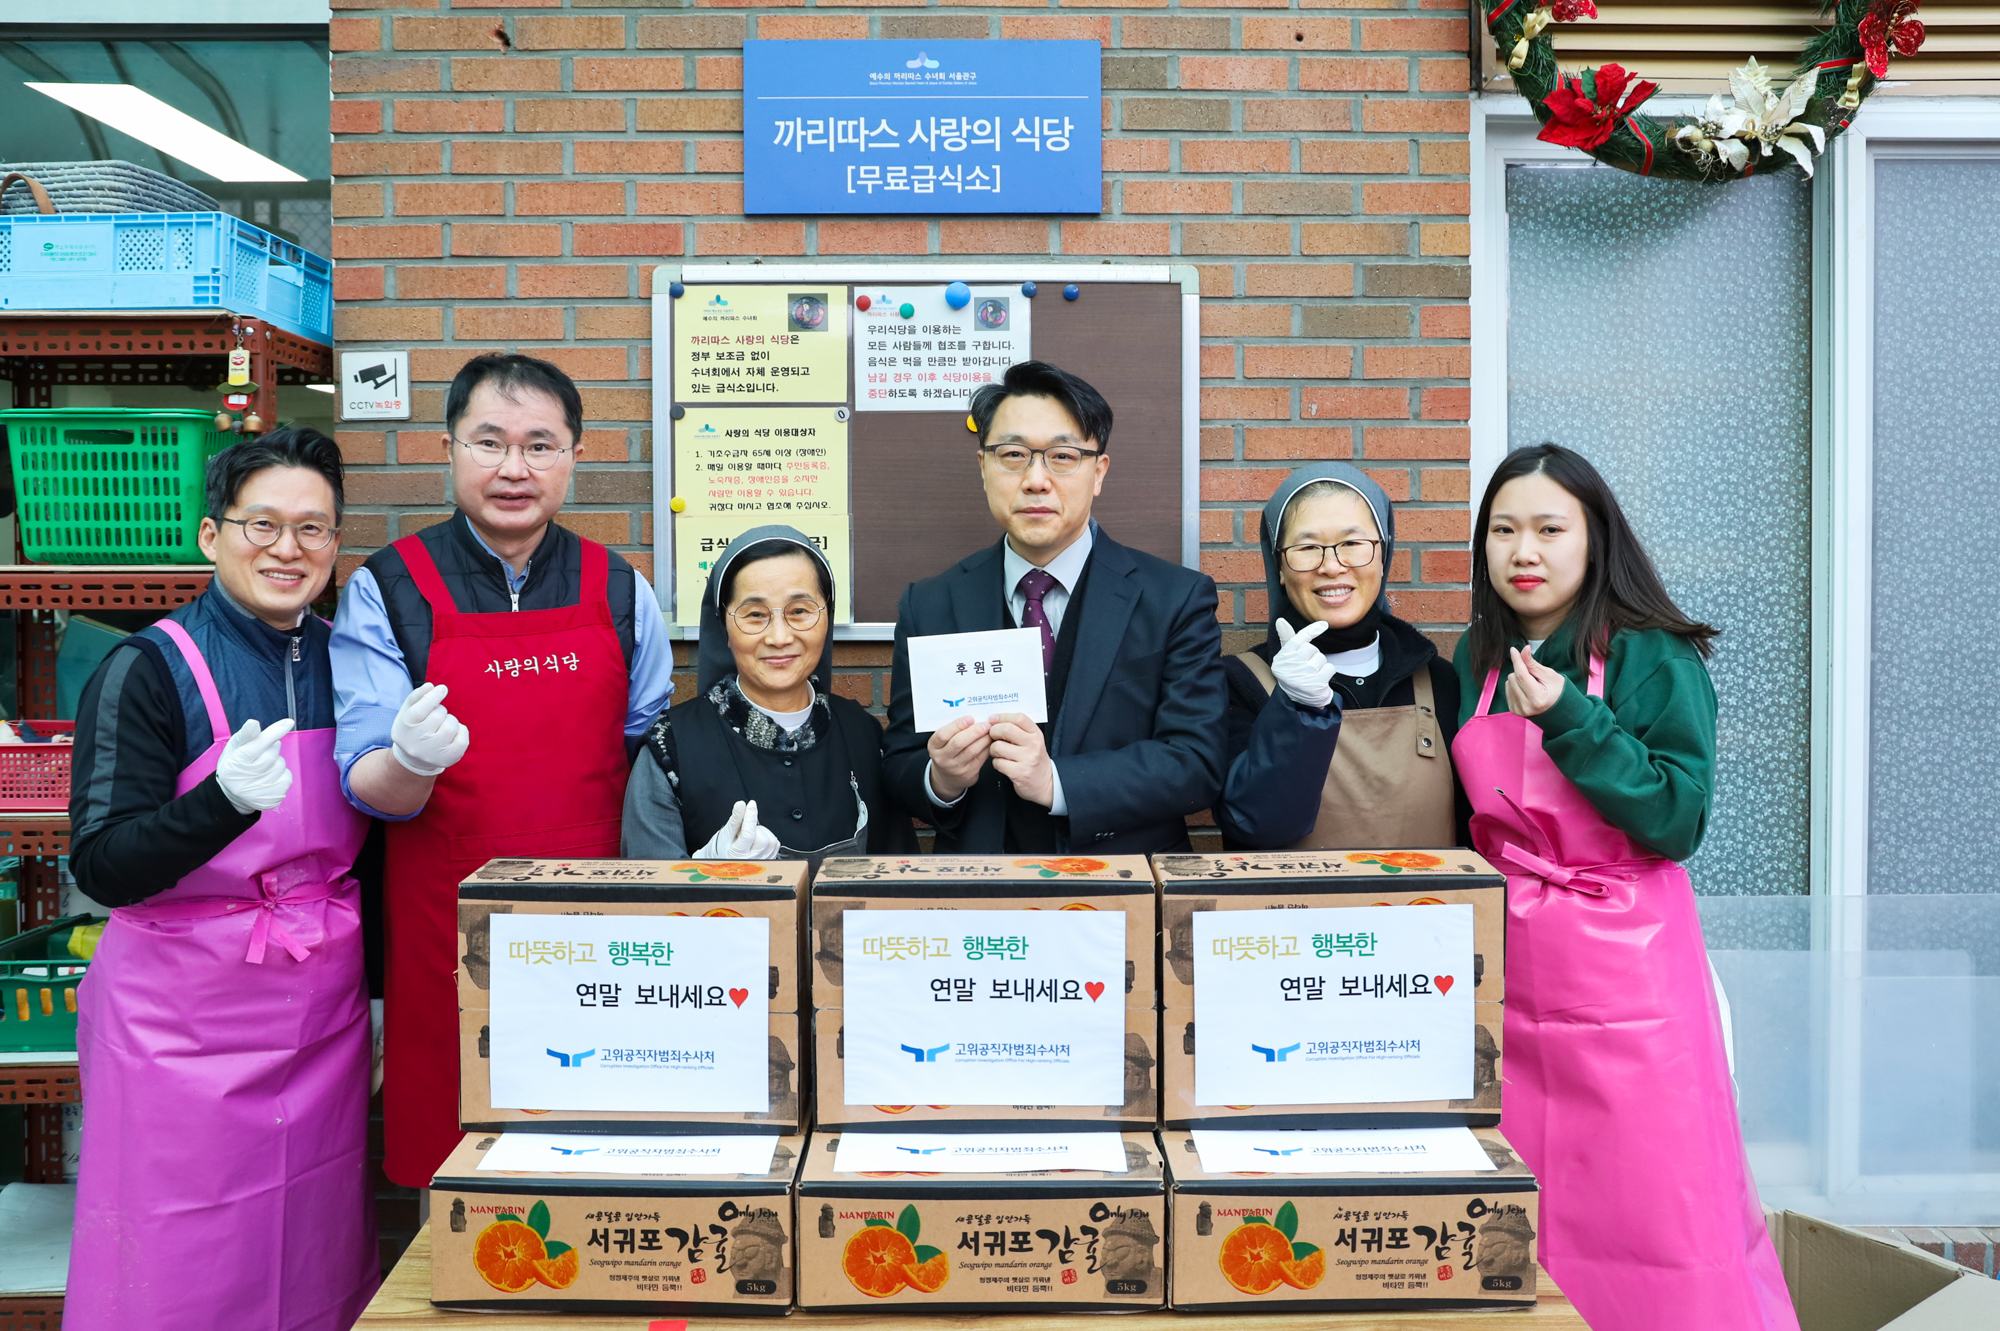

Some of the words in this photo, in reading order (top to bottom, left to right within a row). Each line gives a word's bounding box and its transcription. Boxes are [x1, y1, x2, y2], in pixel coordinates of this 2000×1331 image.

[869, 72, 891, 81] 예수의
[893, 72, 922, 81] 까리따스
[924, 72, 946, 81] 수녀회
[773, 117, 900, 153] 까리따스
[908, 116, 1001, 152] 사랑의
[1011, 116, 1075, 152] 식당
[847, 164, 1001, 194] [무료급식소]
[867, 324, 917, 335] 우리식당을
[922, 324, 962, 335] 이용하는
[690, 335, 731, 345] 까리따스
[735, 335, 765, 345] 사랑의
[770, 334, 800, 345] 식당은
[867, 341, 887, 351] 모든
[892, 341, 932, 351] 사람들께
[937, 341, 966, 351] 협조를
[971, 341, 1015, 351] 구합니다.
[690, 351, 711, 362] 정부
[716, 351, 745, 361] 보조금
[750, 350, 770, 361] 없이
[867, 356, 898, 367] 음식은
[903, 356, 922, 367] 먹을
[927, 356, 957, 367] 만큼만
[690, 367, 741, 377] 수녀회에서
[745, 366, 766, 377] 자체
[770, 366, 810, 377] 운영되고
[868, 373, 887, 383] 남길
[893, 373, 912, 383] 경우
[917, 373, 937, 383] 이후
[943, 373, 992, 383] 식당이용을
[691, 383, 711, 394] 있는
[716, 382, 779, 393] 급식소입니다.
[868, 388, 918, 399] 중단하도록
[724, 428, 750, 438] 사랑의
[753, 428, 770, 437] 식당
[774, 428, 816, 437] 이용대상자
[695, 450, 703, 458] 1.
[752, 449, 771, 457] 65세
[775, 448, 792, 457] 이상
[795, 448, 827, 456] (장애인)
[695, 463, 703, 471] 2.
[707, 463, 724, 471] 매일
[766, 489, 775, 497] 수
[779, 488, 815, 497] 있습니다.
[737, 502, 762, 510] 마시고
[863, 936, 951, 961] 따뜻하고
[963, 936, 1029, 961] 행복한
[1212, 935, 1301, 961] 따뜻하고
[1311, 932, 1378, 958] 행복한
[509, 941, 597, 965] 따뜻하고
[608, 941, 674, 966] 행복한
[930, 978, 976, 1002] 연말
[990, 978, 1083, 1003] 보내세요
[1280, 976, 1326, 1001] 연말
[1339, 973, 1432, 999] 보내세요
[576, 983, 622, 1007] 연말
[635, 984, 727, 1009] 보내세요
[955, 1043, 1070, 1056] 고위공직자범죄수사처
[1306, 1039, 1420, 1054] 고위공직자범죄수사처
[600, 1048, 715, 1063] 고위공직자범죄수사처
[470, 1206, 525, 1214] MANDARIN
[718, 1201, 755, 1223] Only
[758, 1208, 778, 1219] Jeju
[1089, 1202, 1126, 1224] Only
[1129, 1209, 1149, 1220] Jeju
[1217, 1208, 1273, 1217] MANDARIN
[1467, 1198, 1503, 1220] Only
[1506, 1205, 1526, 1216] Jeju
[625, 1212, 660, 1222] 입안가득
[839, 1211, 895, 1219] MANDARIN
[995, 1214, 1032, 1224] 입안가득
[1374, 1211, 1409, 1221] 입안가득
[587, 1228, 663, 1254] 서귀포
[665, 1224, 736, 1274] 감귤
[957, 1231, 1033, 1256] 서귀포
[1035, 1225, 1108, 1274] 감귤
[1334, 1227, 1410, 1253] 서귀포
[1413, 1221, 1485, 1270] 감귤
[589, 1259, 622, 1268] Seogwipo
[624, 1258, 657, 1266] mandarin
[658, 1261, 682, 1269] orange
[959, 1261, 992, 1270] Seogwipo
[994, 1260, 1027, 1268] mandarin
[1029, 1262, 1052, 1270] orange
[1335, 1258, 1369, 1267] Seogwipo
[1405, 1258, 1429, 1266] orange
[746, 1282, 766, 1292] 5kg
[1117, 1283, 1137, 1292] 5kg
[1492, 1279, 1512, 1287] 5kg
